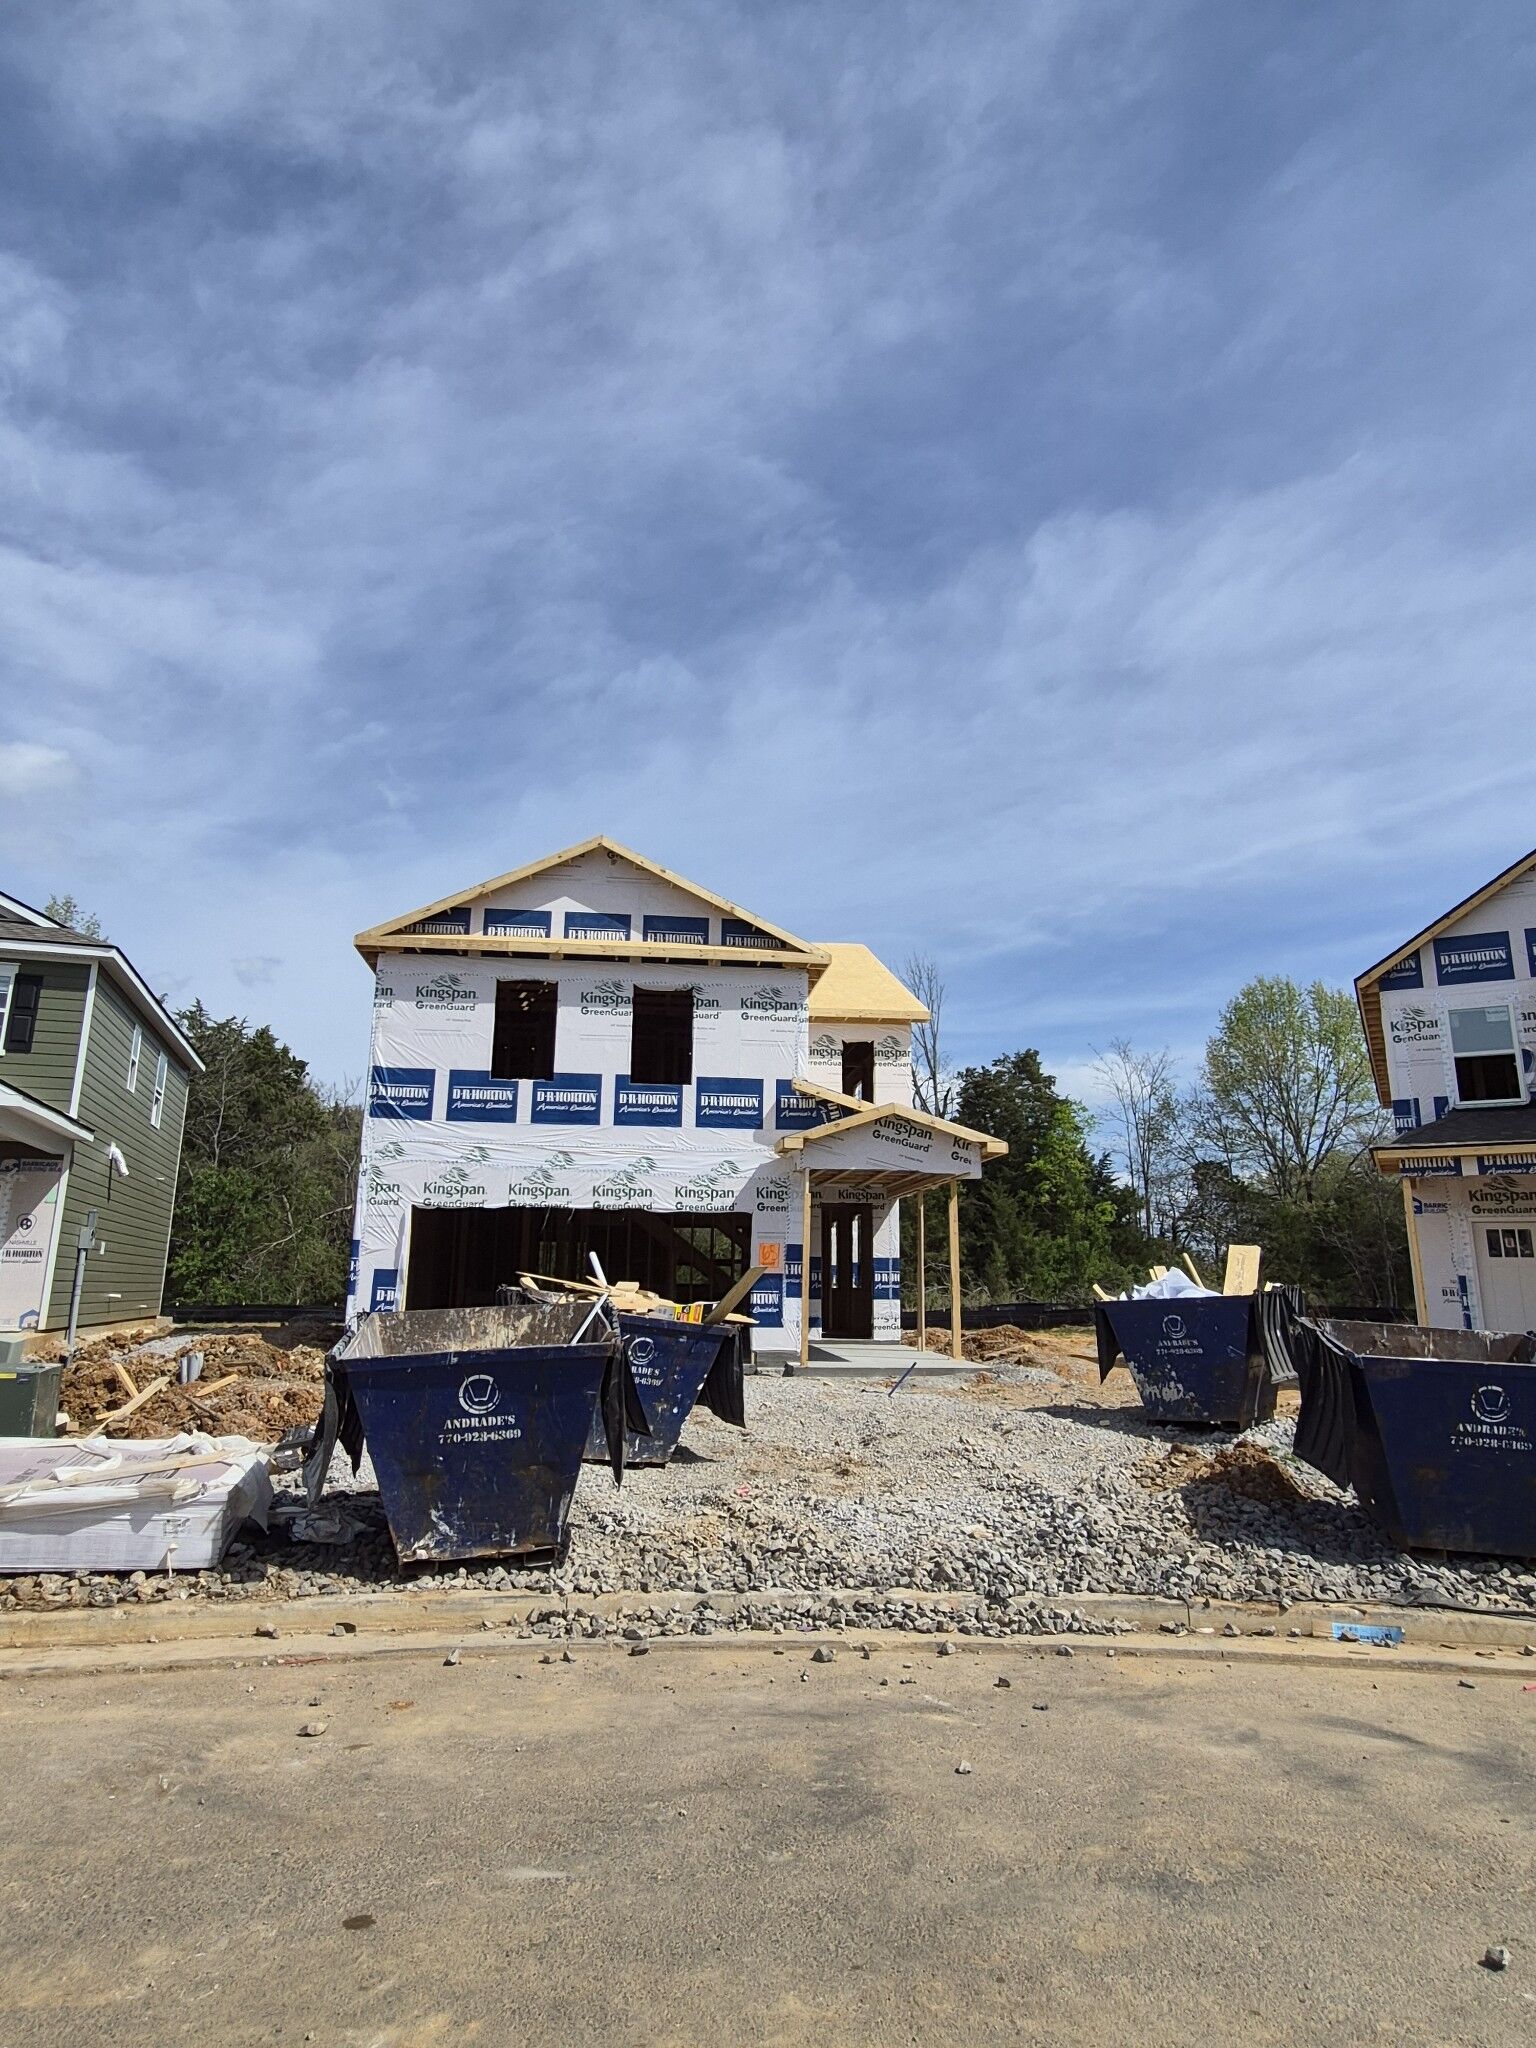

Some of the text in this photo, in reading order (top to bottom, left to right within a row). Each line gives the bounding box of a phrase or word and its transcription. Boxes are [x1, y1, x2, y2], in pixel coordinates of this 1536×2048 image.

[416, 985, 477, 1000] Kingspan
[580, 992, 632, 1006] Kingspa
[415, 1001, 476, 1012] GreenGuard
[741, 997, 797, 1012] Kingspan
[872, 1130, 930, 1153] GreenGuard
[424, 1182, 486, 1197] Kingspan
[509, 1183, 569, 1199] Kingspan
[592, 1185, 652, 1201] Kingspan
[675, 1186, 735, 1201] Kingspan
[756, 1186, 789, 1202] Kings
[838, 1189, 884, 1202] Kingspan
[444, 1415, 516, 1430] ANDRADE'S
